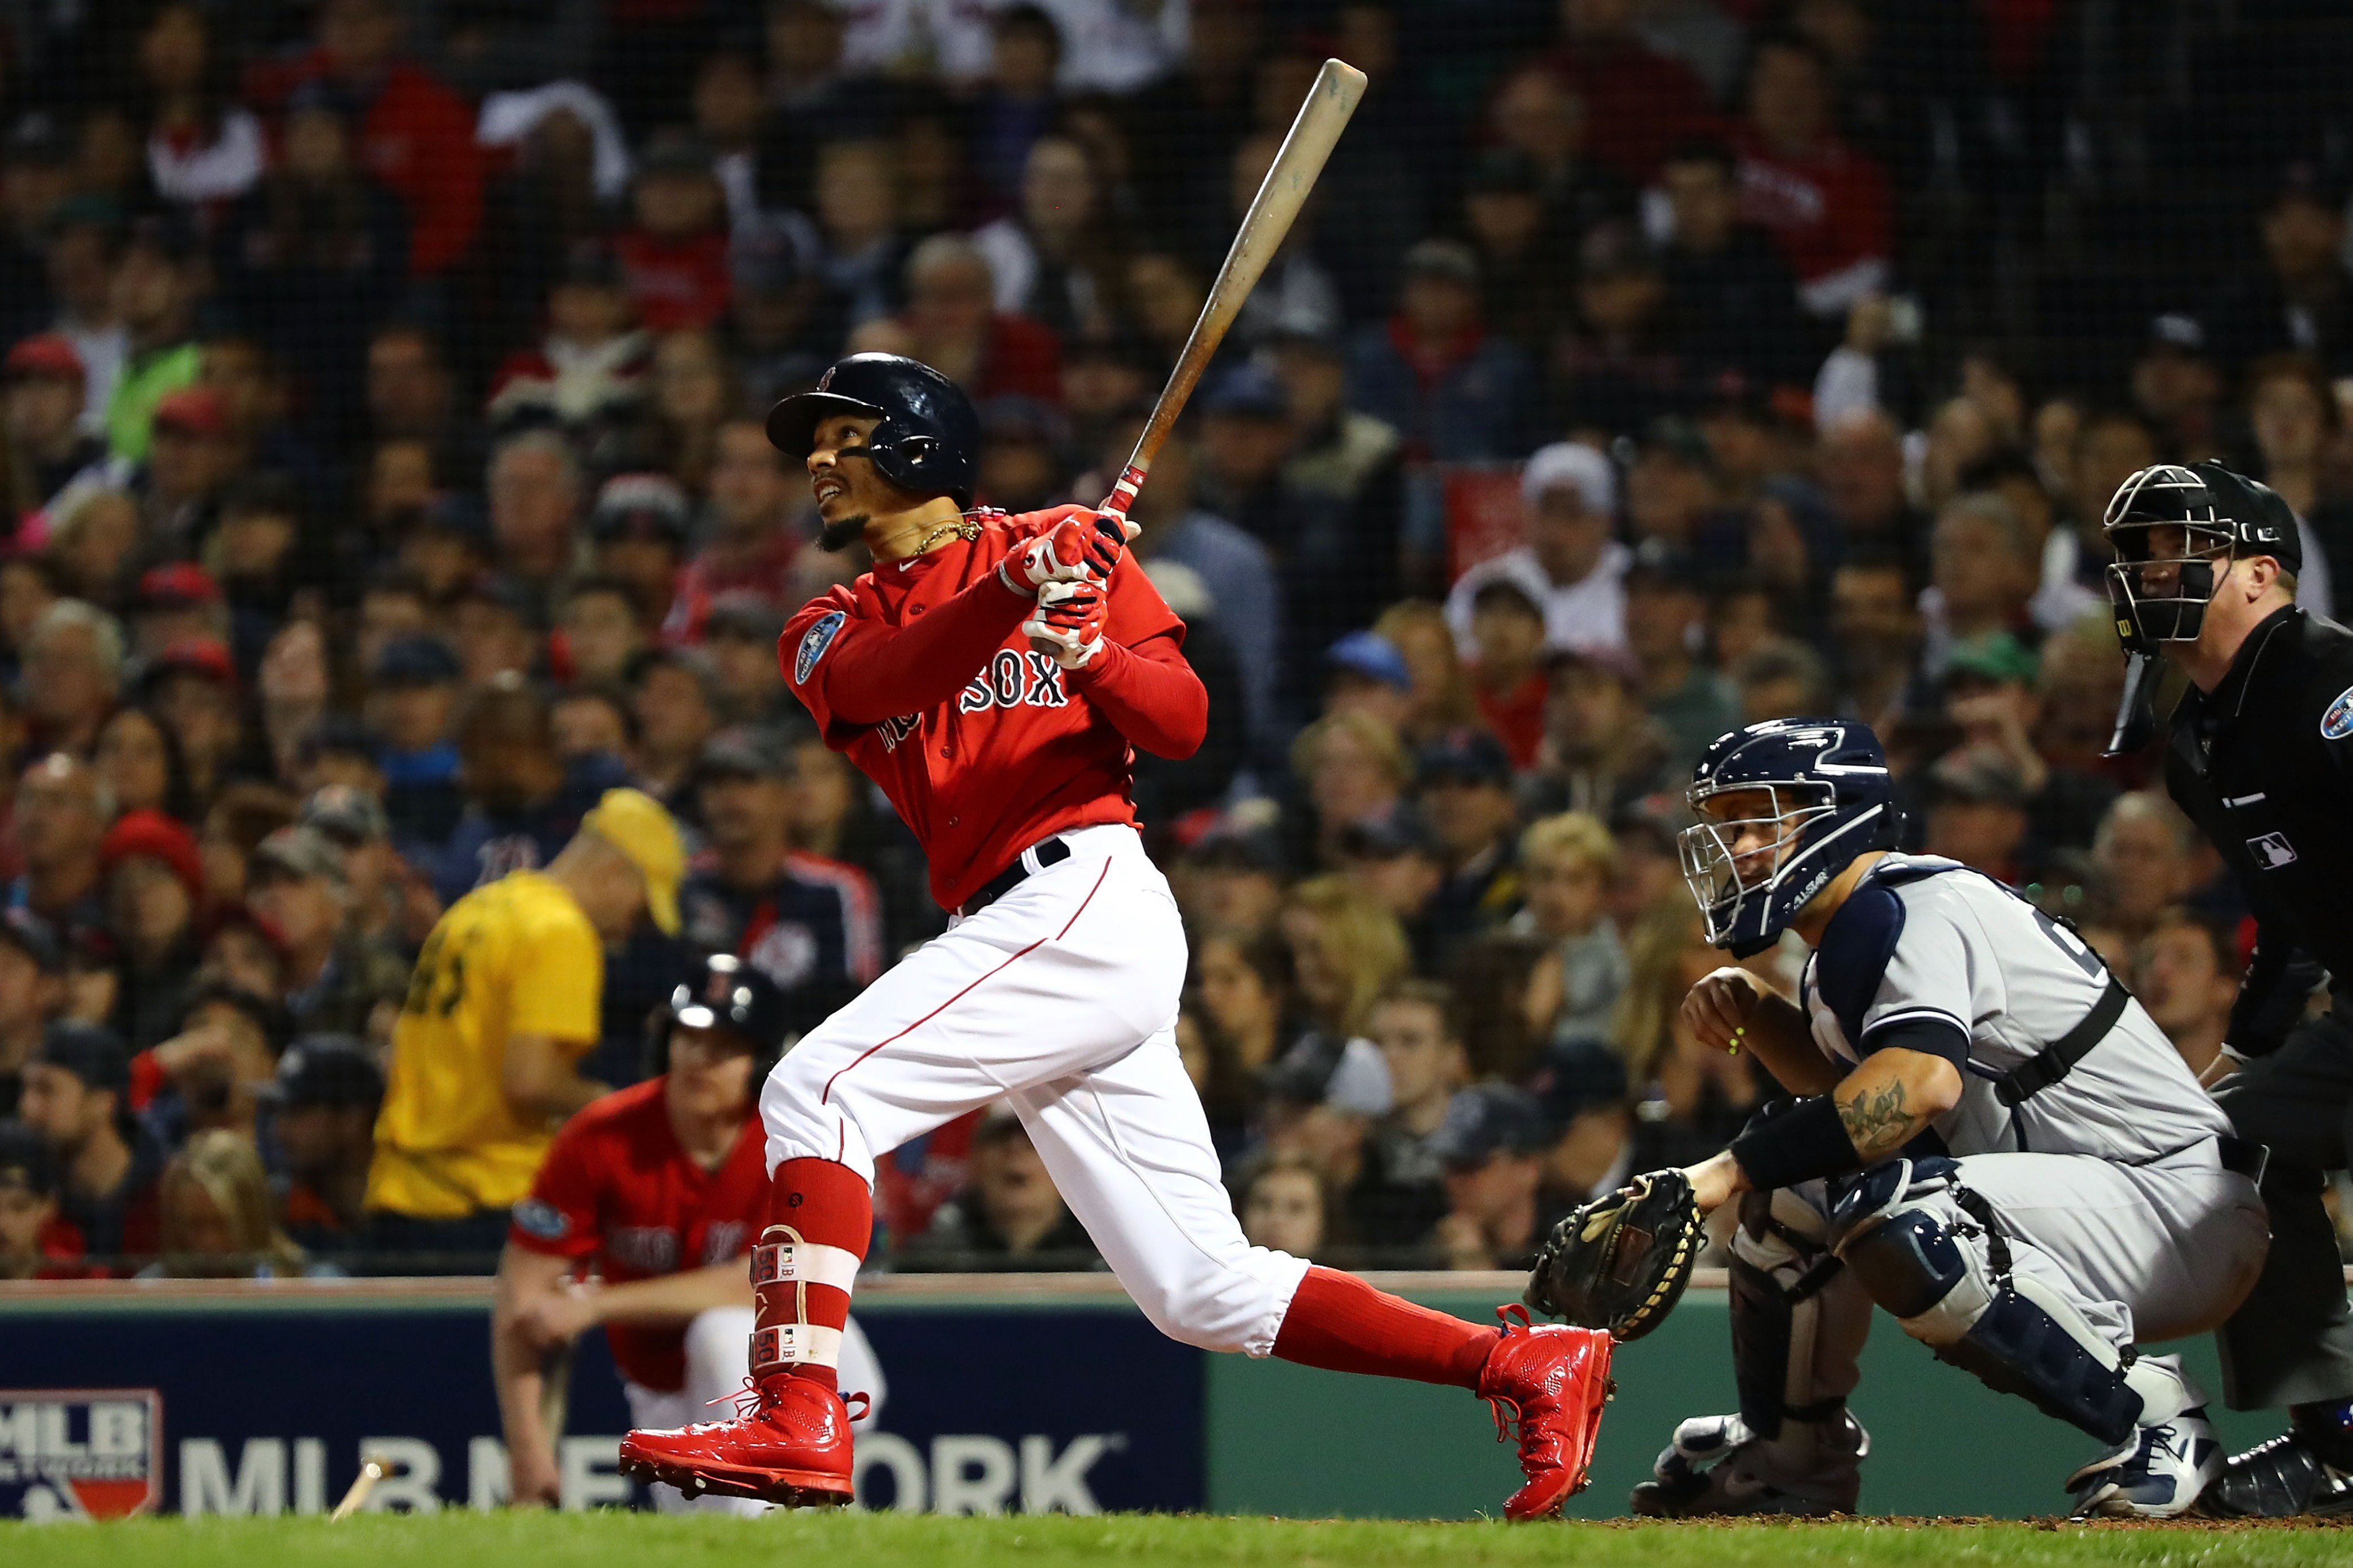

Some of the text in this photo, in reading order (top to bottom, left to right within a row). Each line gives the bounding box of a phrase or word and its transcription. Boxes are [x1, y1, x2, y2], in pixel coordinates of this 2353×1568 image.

[959, 648, 1069, 715] SOX
[759, 1250, 774, 1280] 50
[758, 1333, 774, 1362] 50
[179, 1436, 442, 1517] MLB
